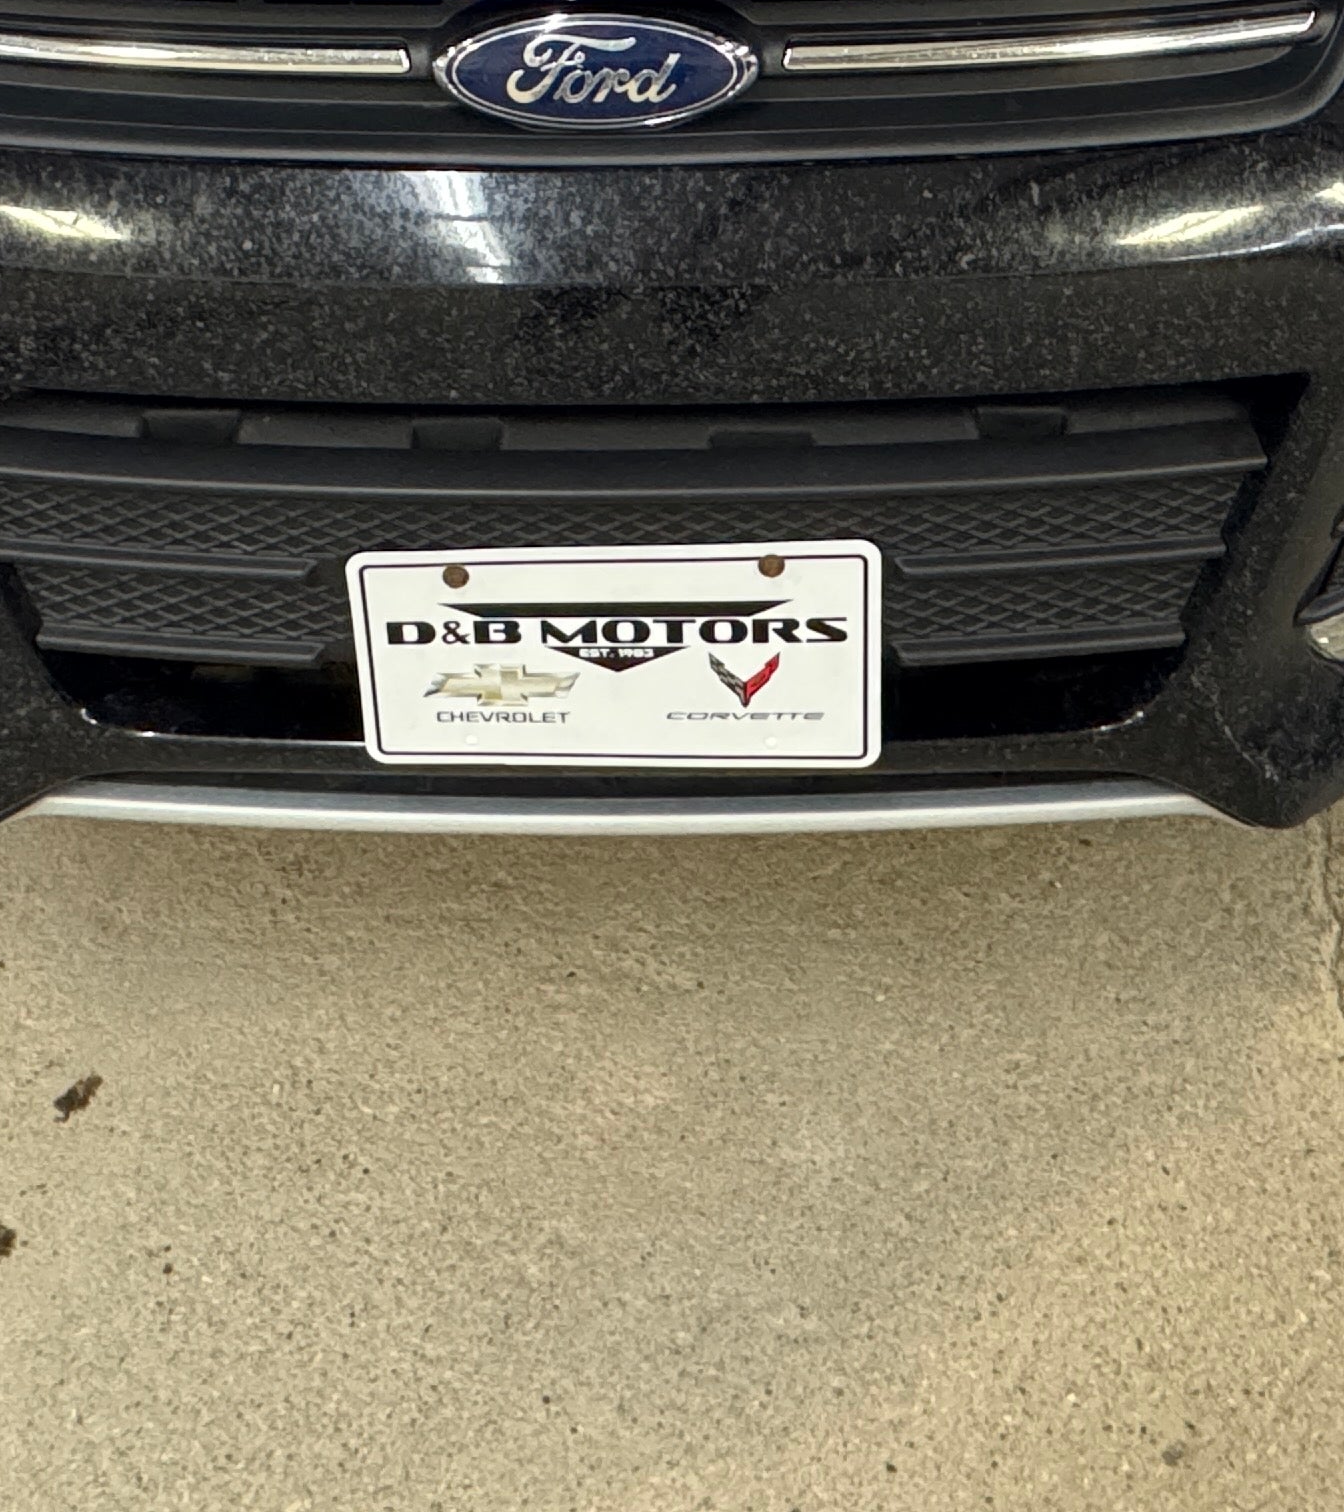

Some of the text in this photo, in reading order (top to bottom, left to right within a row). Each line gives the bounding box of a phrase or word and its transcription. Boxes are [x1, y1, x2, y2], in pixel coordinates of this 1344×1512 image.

[506, 34, 682, 103] Ford
[386, 617, 848, 645] D&B MOTORS
[436, 710, 570, 724] CHEVROLET
[666, 711, 824, 721] CORVETTE
